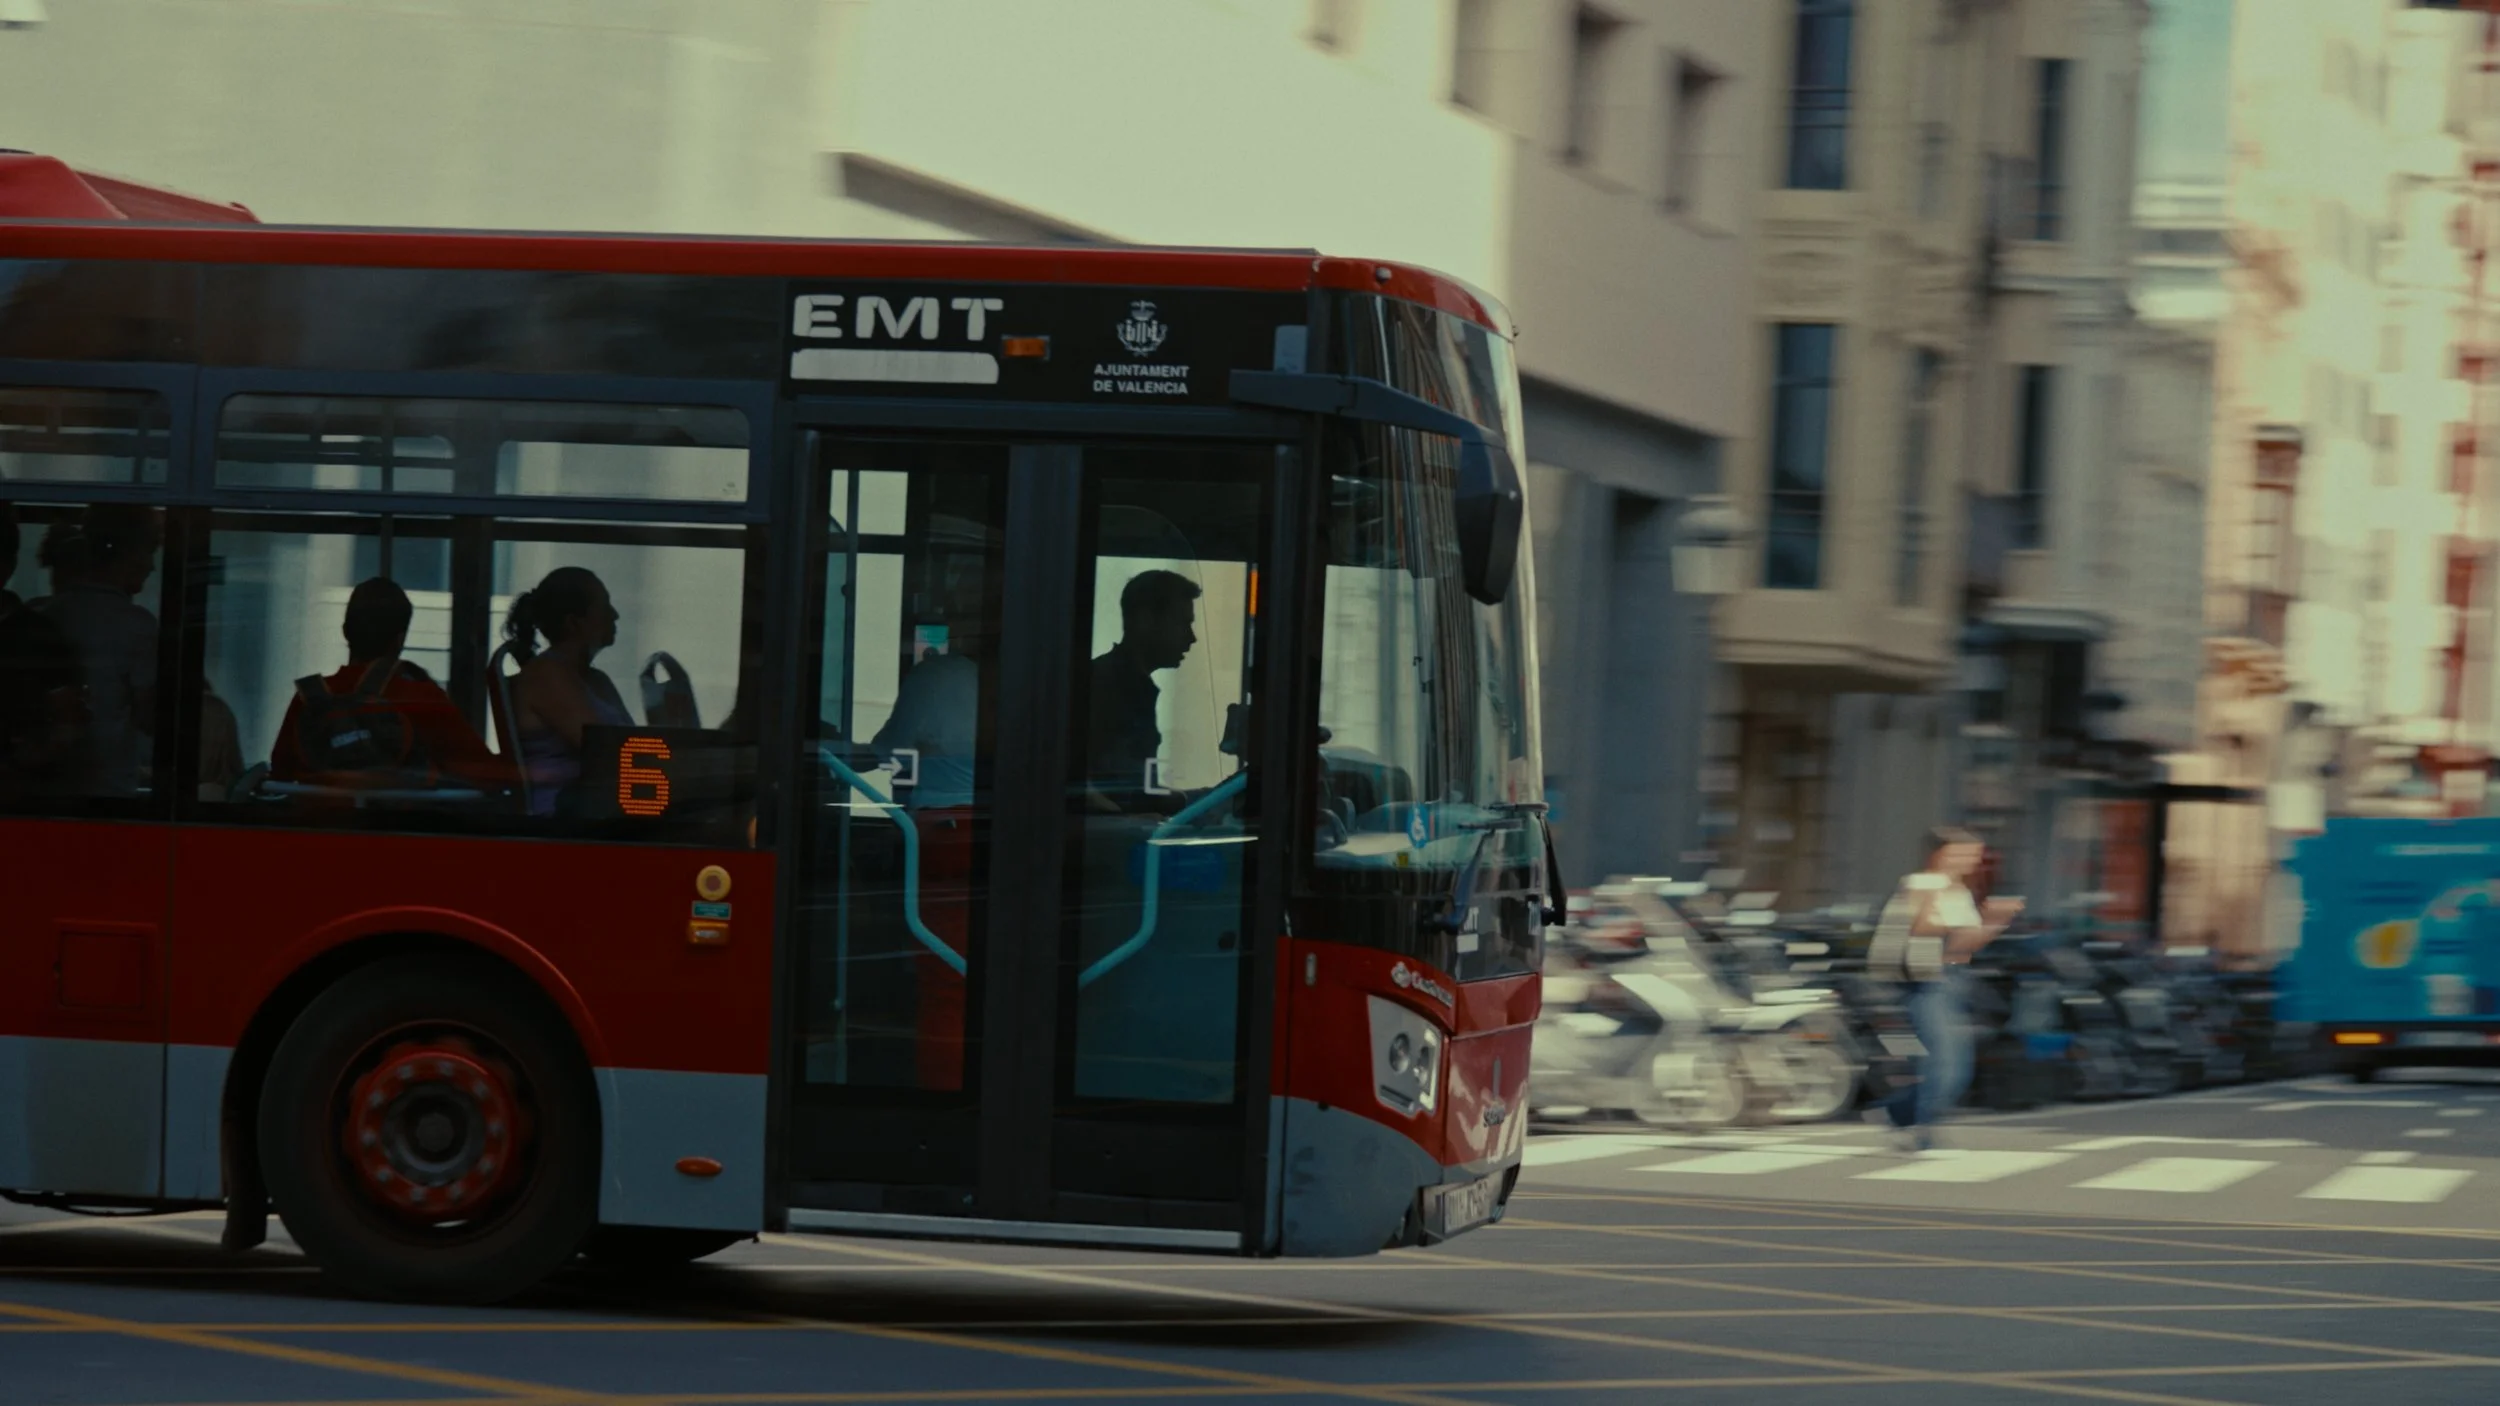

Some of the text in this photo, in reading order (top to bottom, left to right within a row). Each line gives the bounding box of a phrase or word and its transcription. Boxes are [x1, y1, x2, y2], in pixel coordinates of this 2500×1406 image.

[792, 294, 1004, 341] EMT
[1093, 363, 1190, 378] AJUNTAMENT
[1092, 380, 1189, 395] DE VALENCIA
[618, 736, 672, 817] 6
